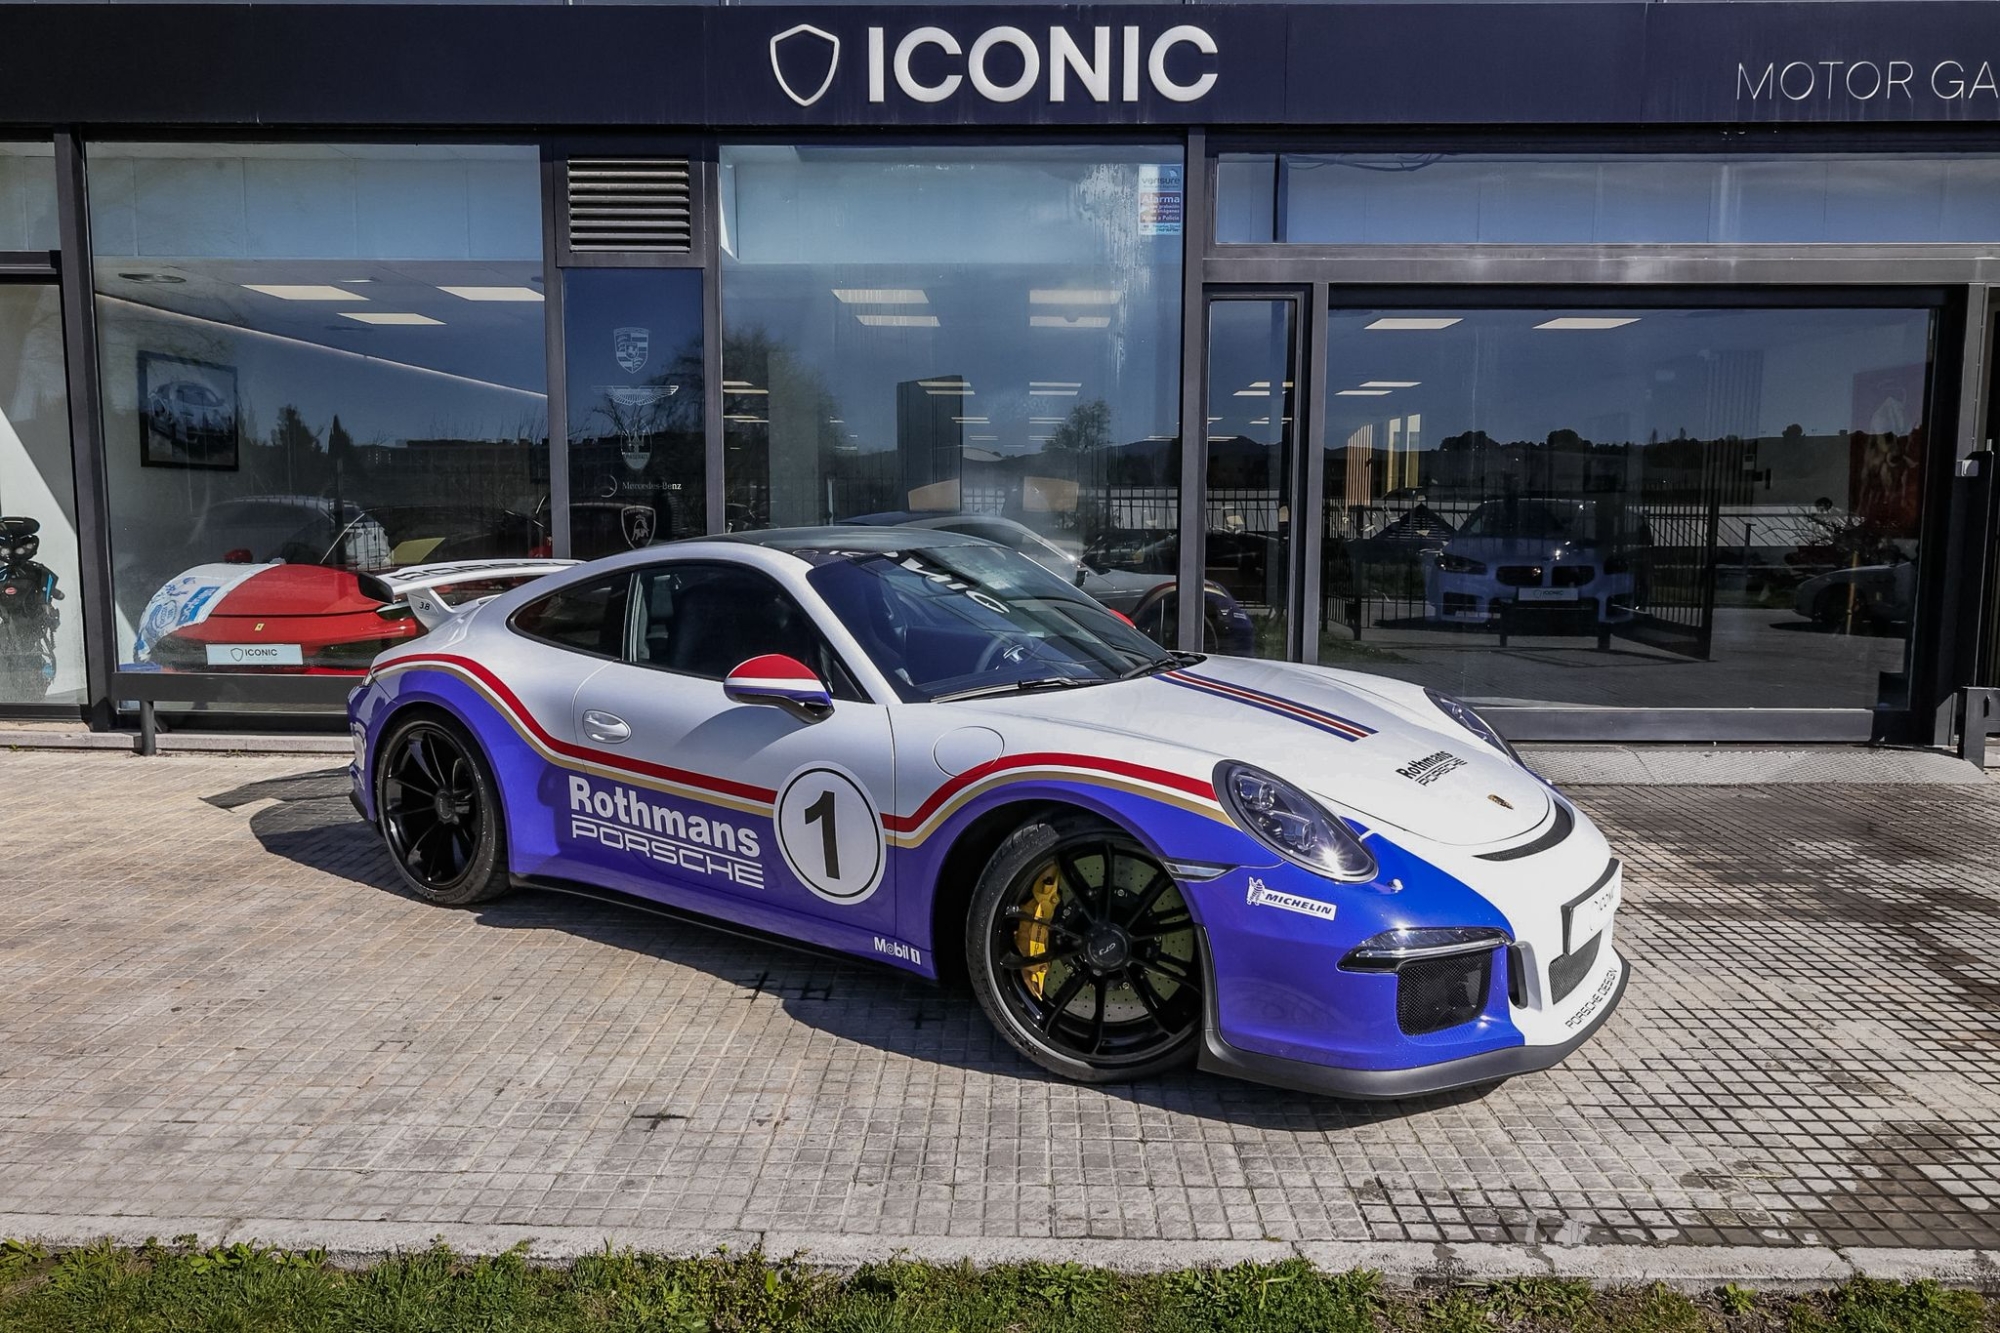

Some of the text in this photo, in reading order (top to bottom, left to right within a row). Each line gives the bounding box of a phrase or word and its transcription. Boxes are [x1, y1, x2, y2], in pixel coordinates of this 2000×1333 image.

[868, 25, 1219, 103] ICONIC
[1737, 61, 2000, 101] MOTOR GA
[1142, 194, 1180, 203] Alarma
[622, 481, 682, 490] Mercedes-Benz
[245, 648, 278, 657] ICONIC
[1395, 750, 1454, 780] Rothmans
[1418, 758, 1468, 787] PORSCHE
[568, 775, 761, 858] Rothmans
[804, 790, 841, 880] 1
[572, 819, 765, 890] PORSCHE
[1265, 893, 1332, 914] MICHELIN
[873, 936, 910, 961] Mobil
[1565, 967, 1618, 1029] PORSCHE DESIGN
